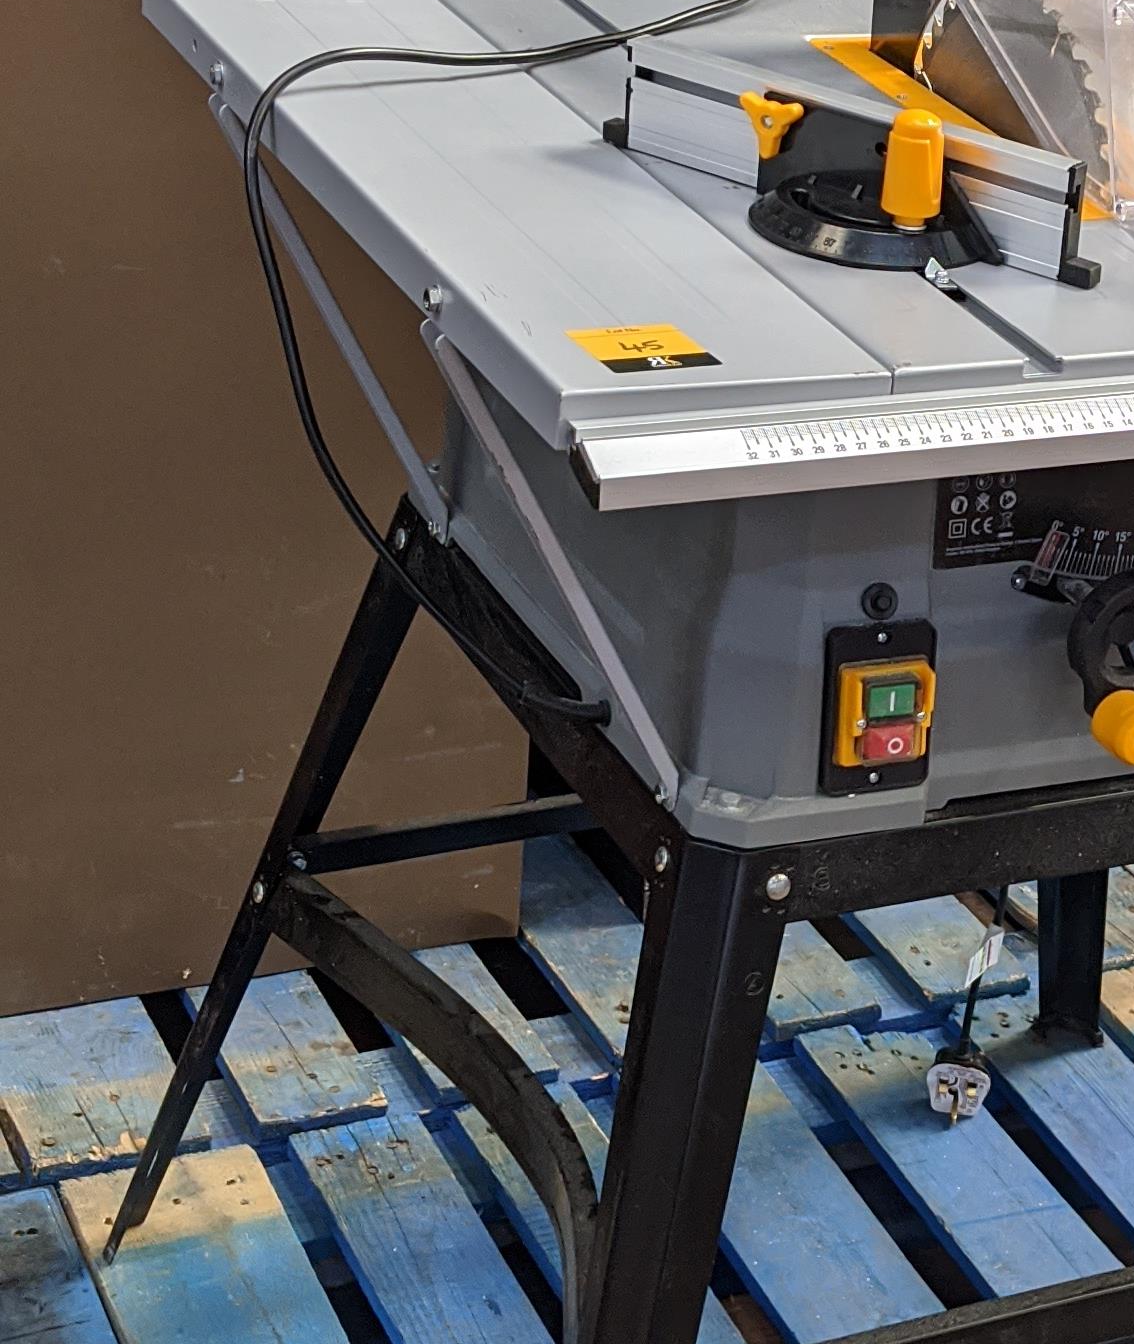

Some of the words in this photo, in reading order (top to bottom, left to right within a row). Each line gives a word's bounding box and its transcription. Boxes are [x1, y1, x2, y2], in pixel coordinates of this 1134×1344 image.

[617, 339, 664, 353] 45
[745, 451, 760, 460] 32
[769, 449, 781, 458] 31
[791, 447, 804, 456] 30
[812, 446, 826, 455] 29
[834, 443, 847, 452] 28
[856, 441, 868, 450] 27
[877, 439, 891, 448] 26
[898, 438, 911, 447] 25
[920, 436, 932, 445] 24
[940, 434, 953, 443] 23
[960, 432, 974, 441] 22
[981, 430, 993, 439] 21
[1002, 428, 1015, 437] 20
[1023, 427, 1035, 436] 19
[1042, 425, 1055, 434] 18
[1063, 423, 1074, 432] 17
[1083, 422, 1095, 430] 16
[1102, 420, 1114, 428] 15
[1122, 418, 1133, 427] 14
[1051, 520, 1063, 531] 0°
[1072, 526, 1085, 538] 5°
[1093, 530, 1110, 541] 10°
[1115, 531, 1131, 542] 15°
